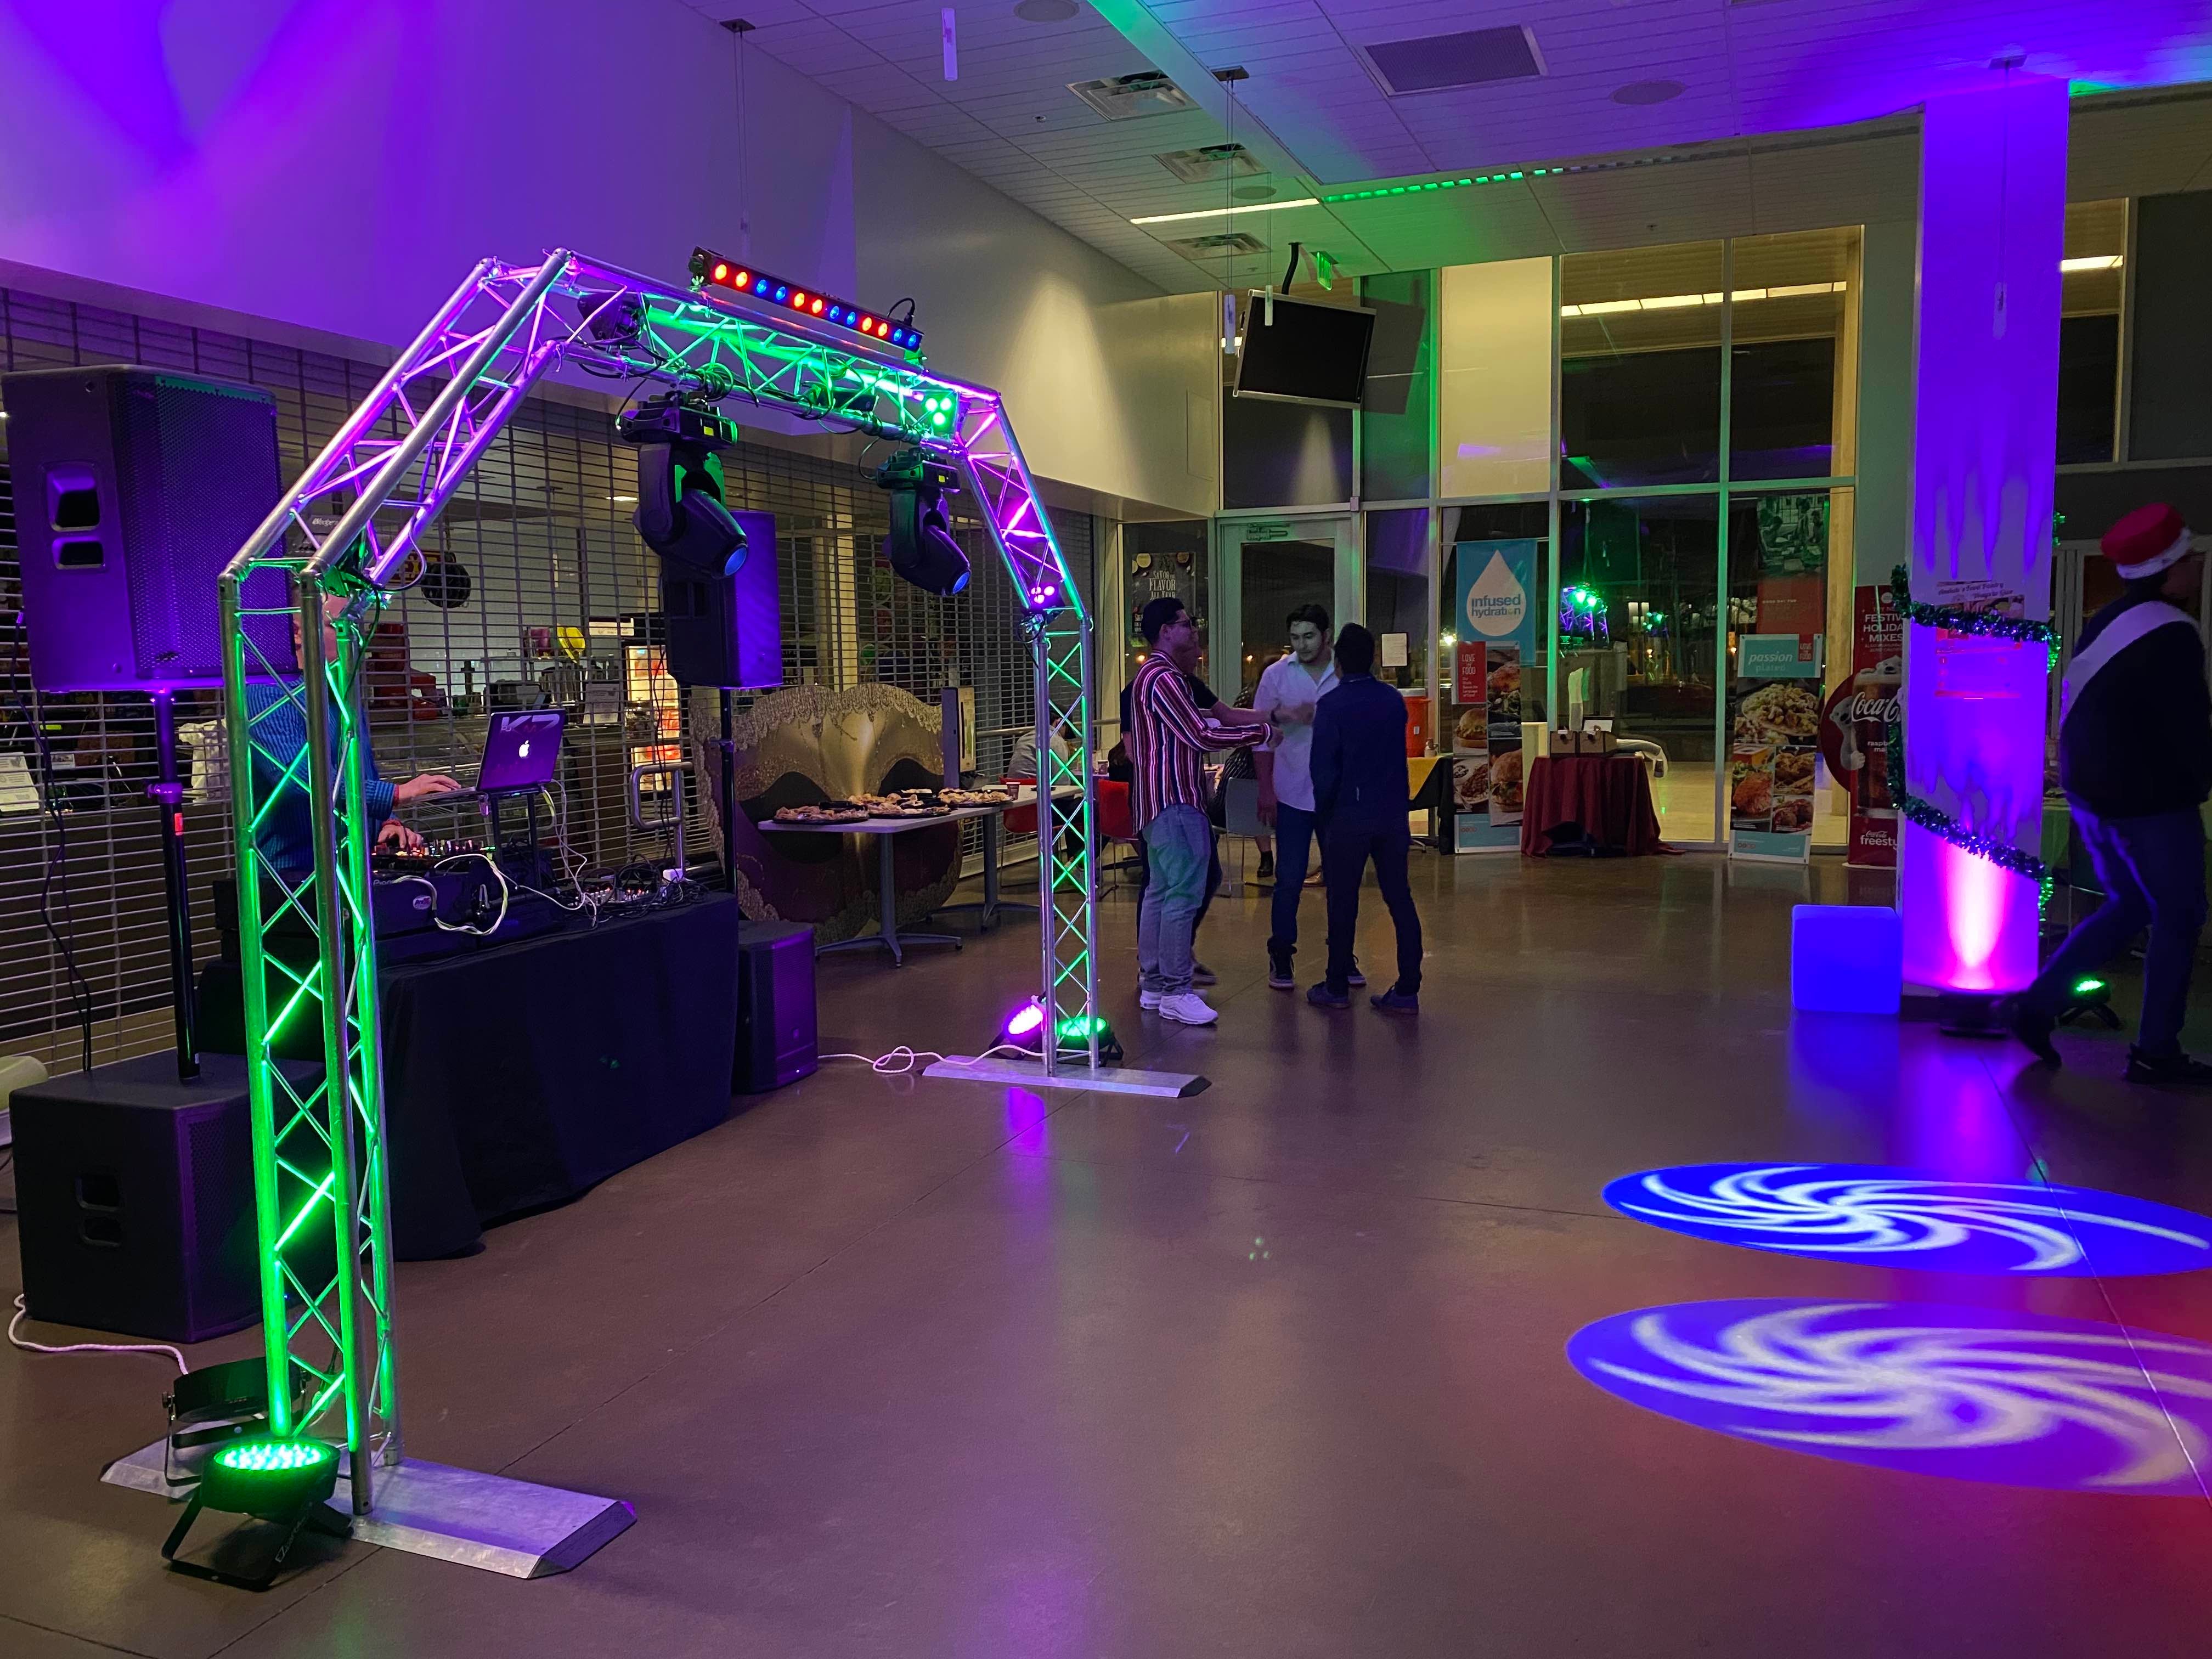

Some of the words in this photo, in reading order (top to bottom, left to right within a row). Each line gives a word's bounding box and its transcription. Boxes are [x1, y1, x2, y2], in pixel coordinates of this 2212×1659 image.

[1153, 570, 1170, 579] SAVOR
[1149, 578, 1176, 591] FLAVOR
[1471, 594, 1521, 607] infused
[1869, 634, 1903, 642] MIXES
[1748, 651, 1793, 665] passion
[1462, 667, 1476, 675] FOOD
[1852, 691, 1901, 723] Coca-C
